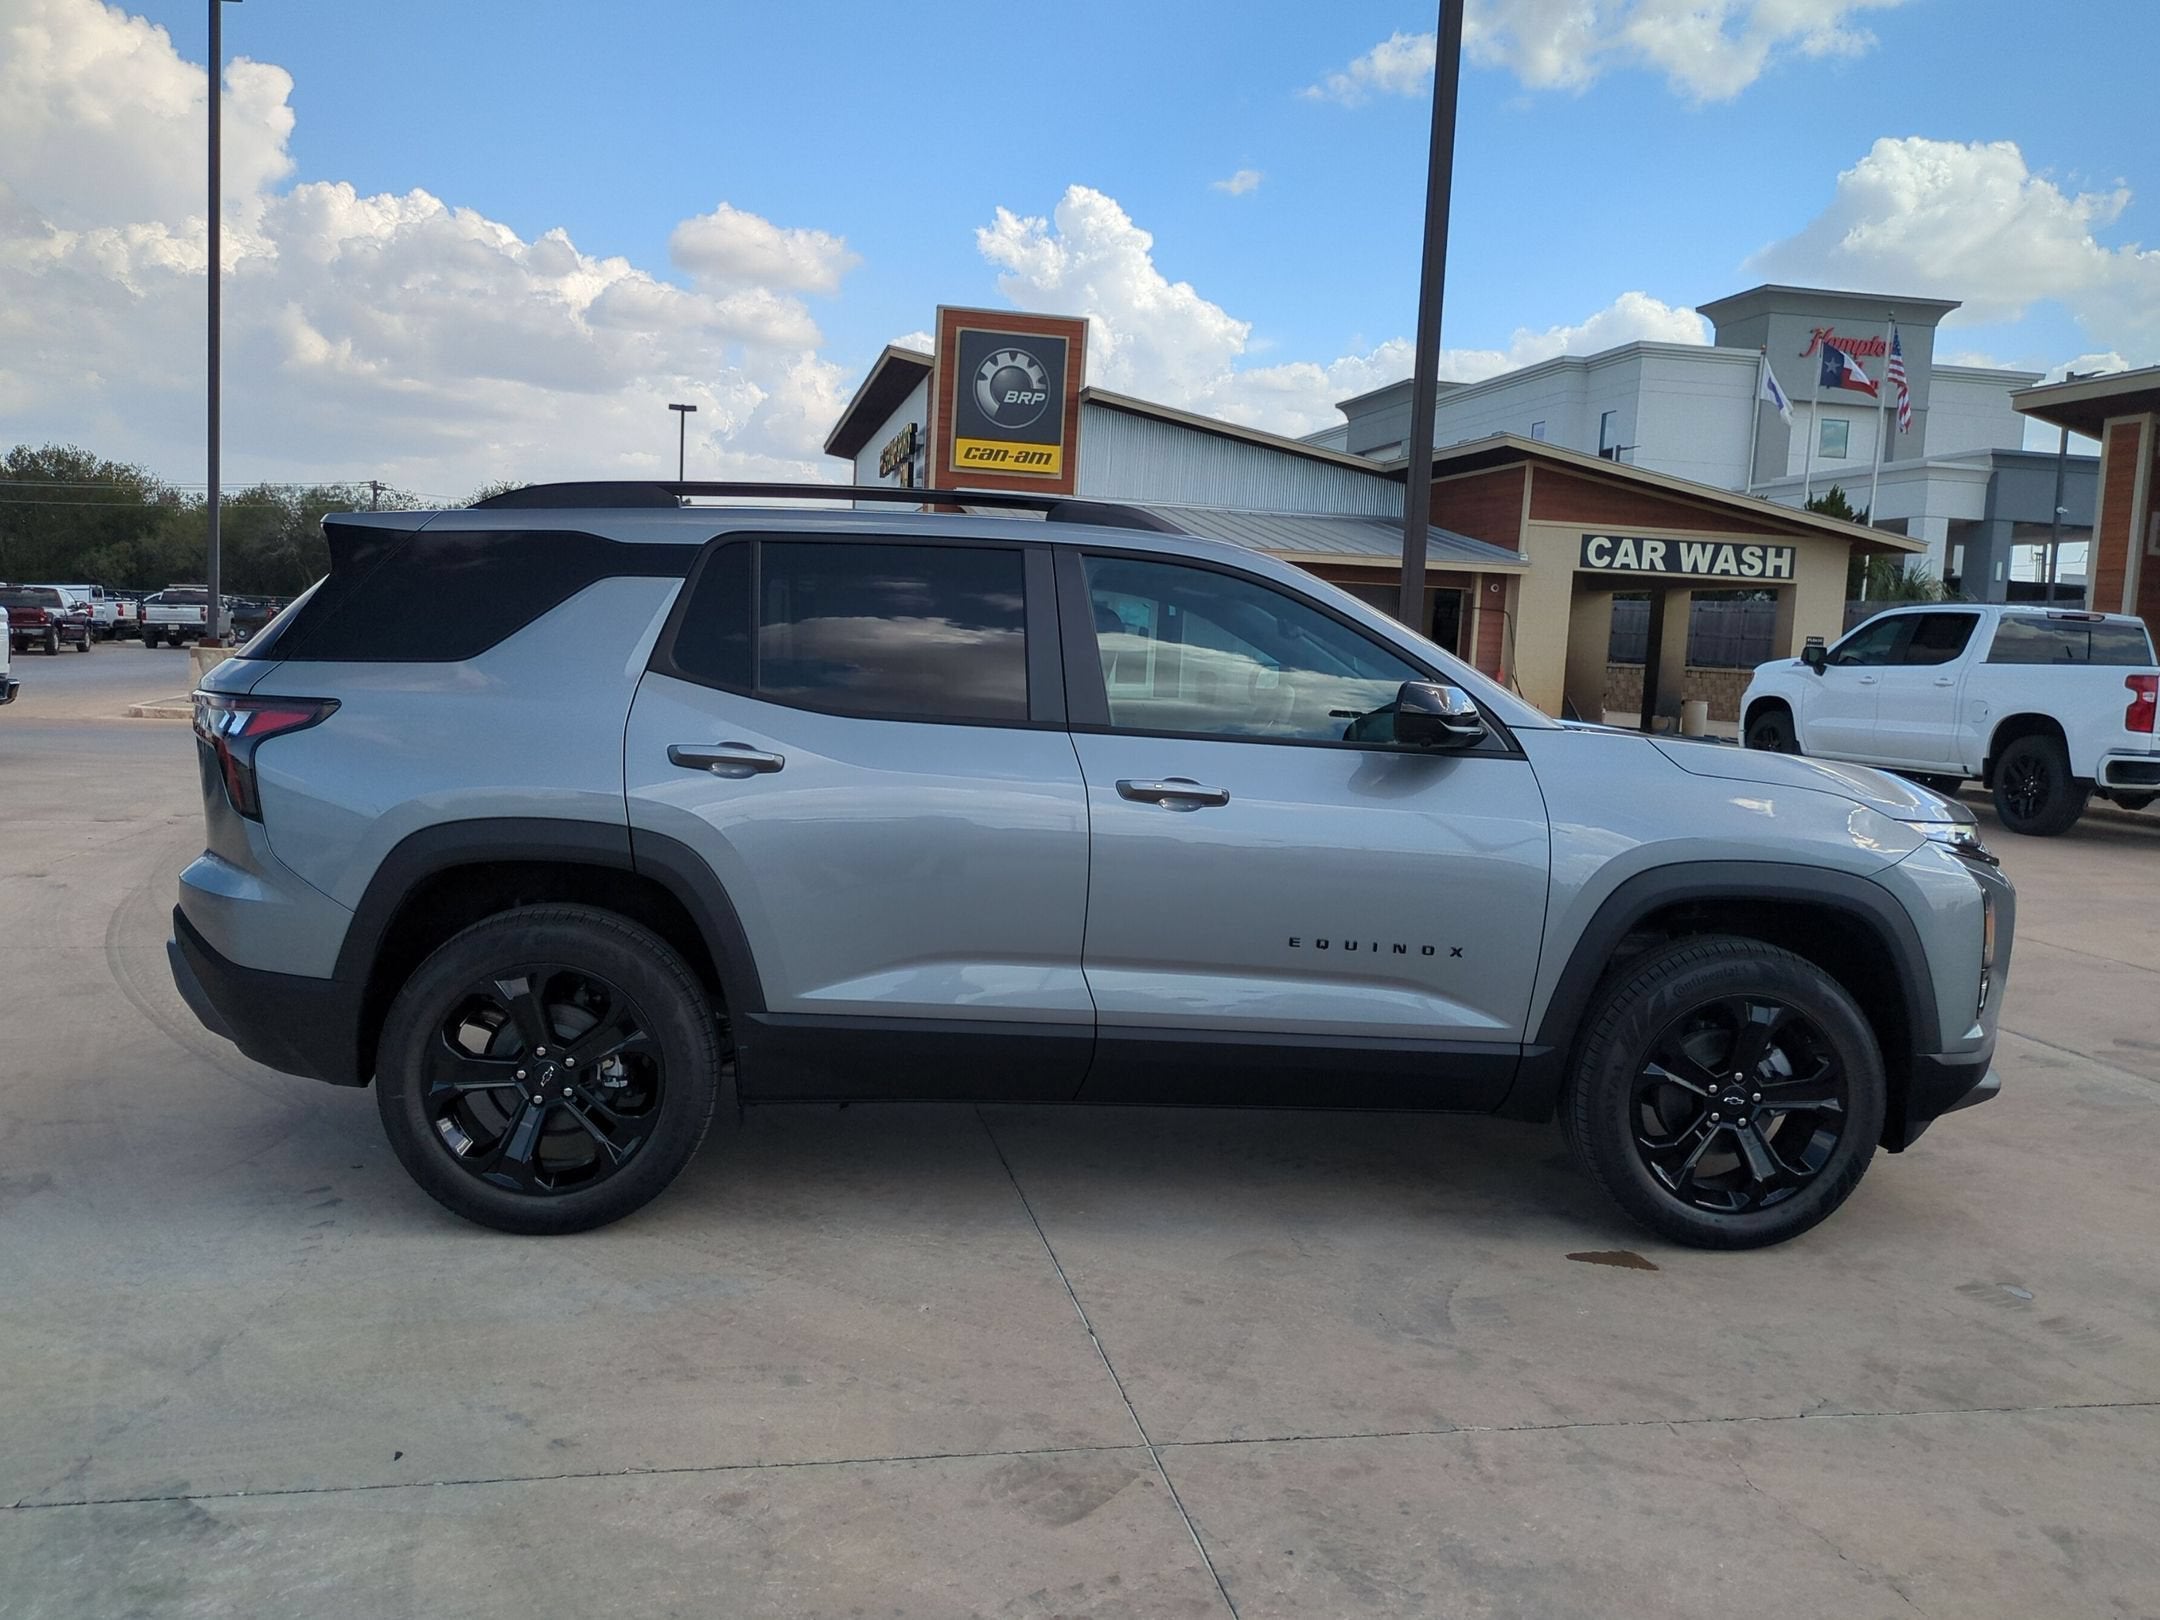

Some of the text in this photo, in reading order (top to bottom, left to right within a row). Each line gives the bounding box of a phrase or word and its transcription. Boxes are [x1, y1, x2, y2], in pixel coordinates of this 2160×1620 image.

[1003, 390, 1046, 405] BRP
[963, 446, 1052, 466] can-am
[1586, 536, 1793, 578] CAR WASH
[1288, 936, 1464, 959] EQUINOX
